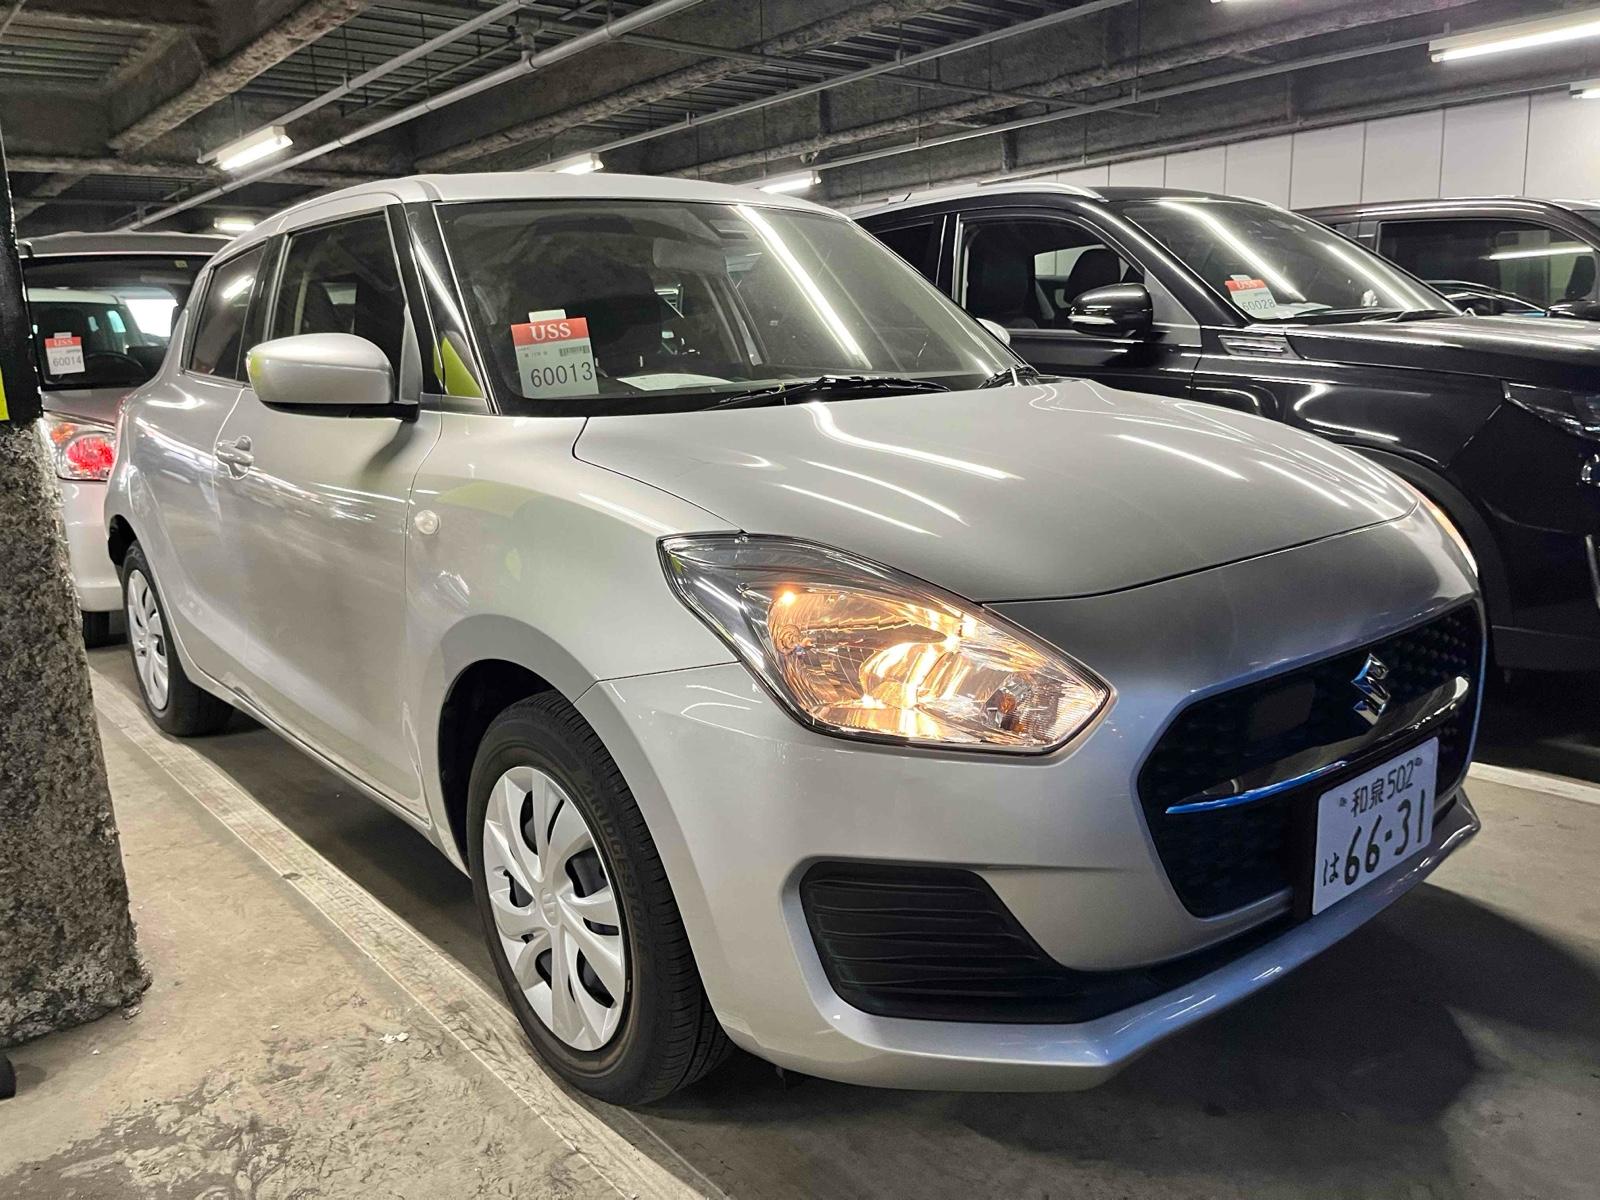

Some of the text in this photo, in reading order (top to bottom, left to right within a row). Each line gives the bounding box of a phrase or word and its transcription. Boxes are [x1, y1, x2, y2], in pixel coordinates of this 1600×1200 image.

[1242, 299, 1275, 311] 60028
[529, 322, 572, 341] USS
[53, 357, 82, 367] 60014
[530, 361, 593, 388] 60013
